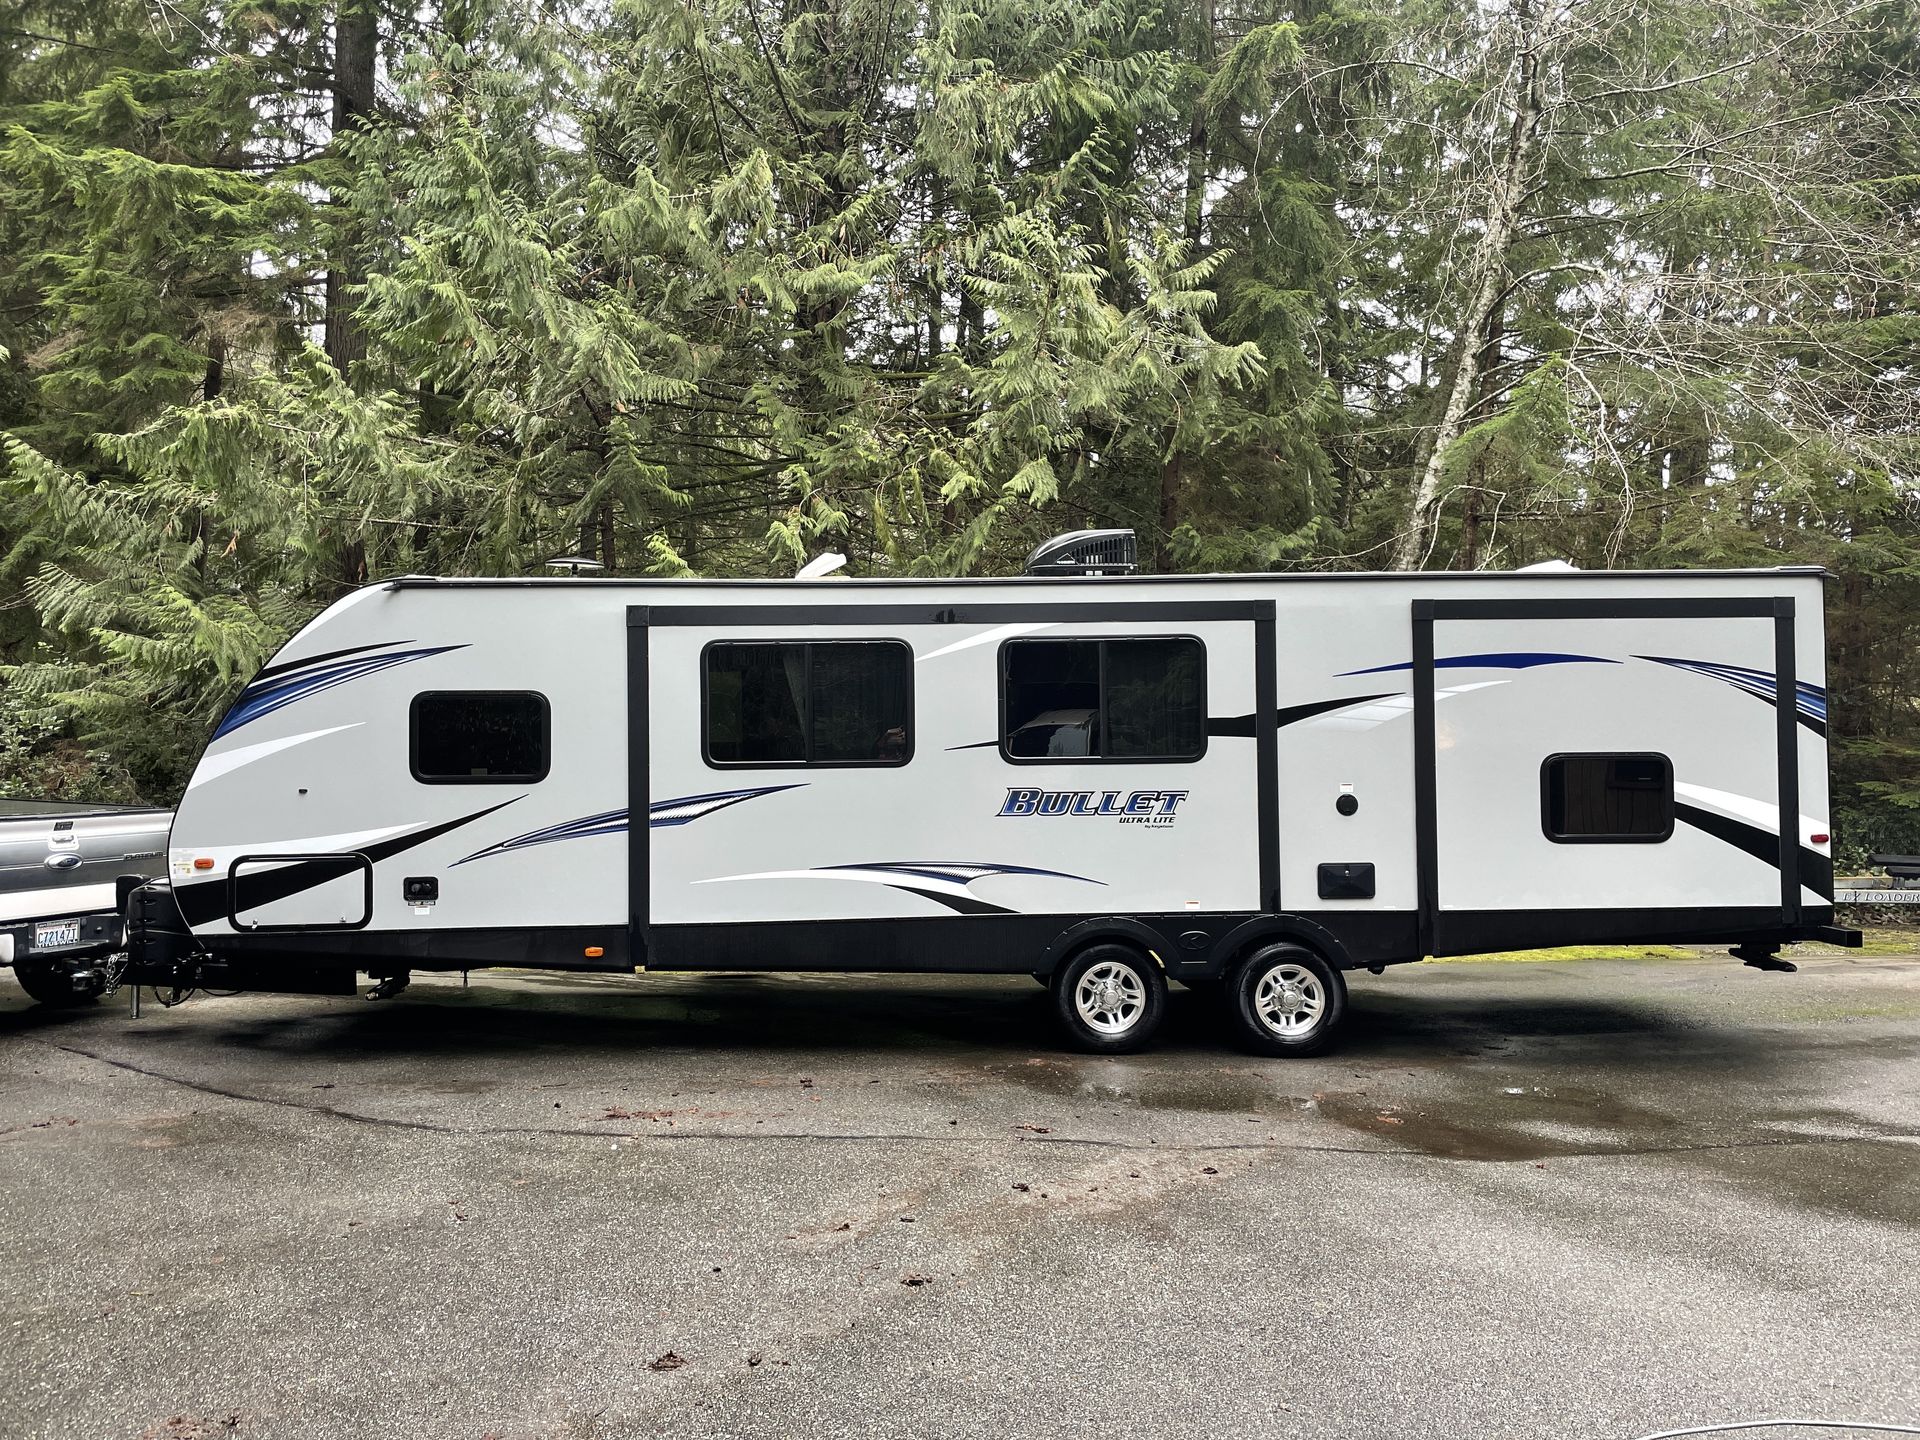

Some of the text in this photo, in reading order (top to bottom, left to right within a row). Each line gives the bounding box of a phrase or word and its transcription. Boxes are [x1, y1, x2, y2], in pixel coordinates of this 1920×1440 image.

[994, 787, 1189, 817] BULLET
[1118, 816, 1176, 824] ULTRA LITE
[1865, 893, 1920, 902] LOADER
[37, 928, 77, 945] C72147T
